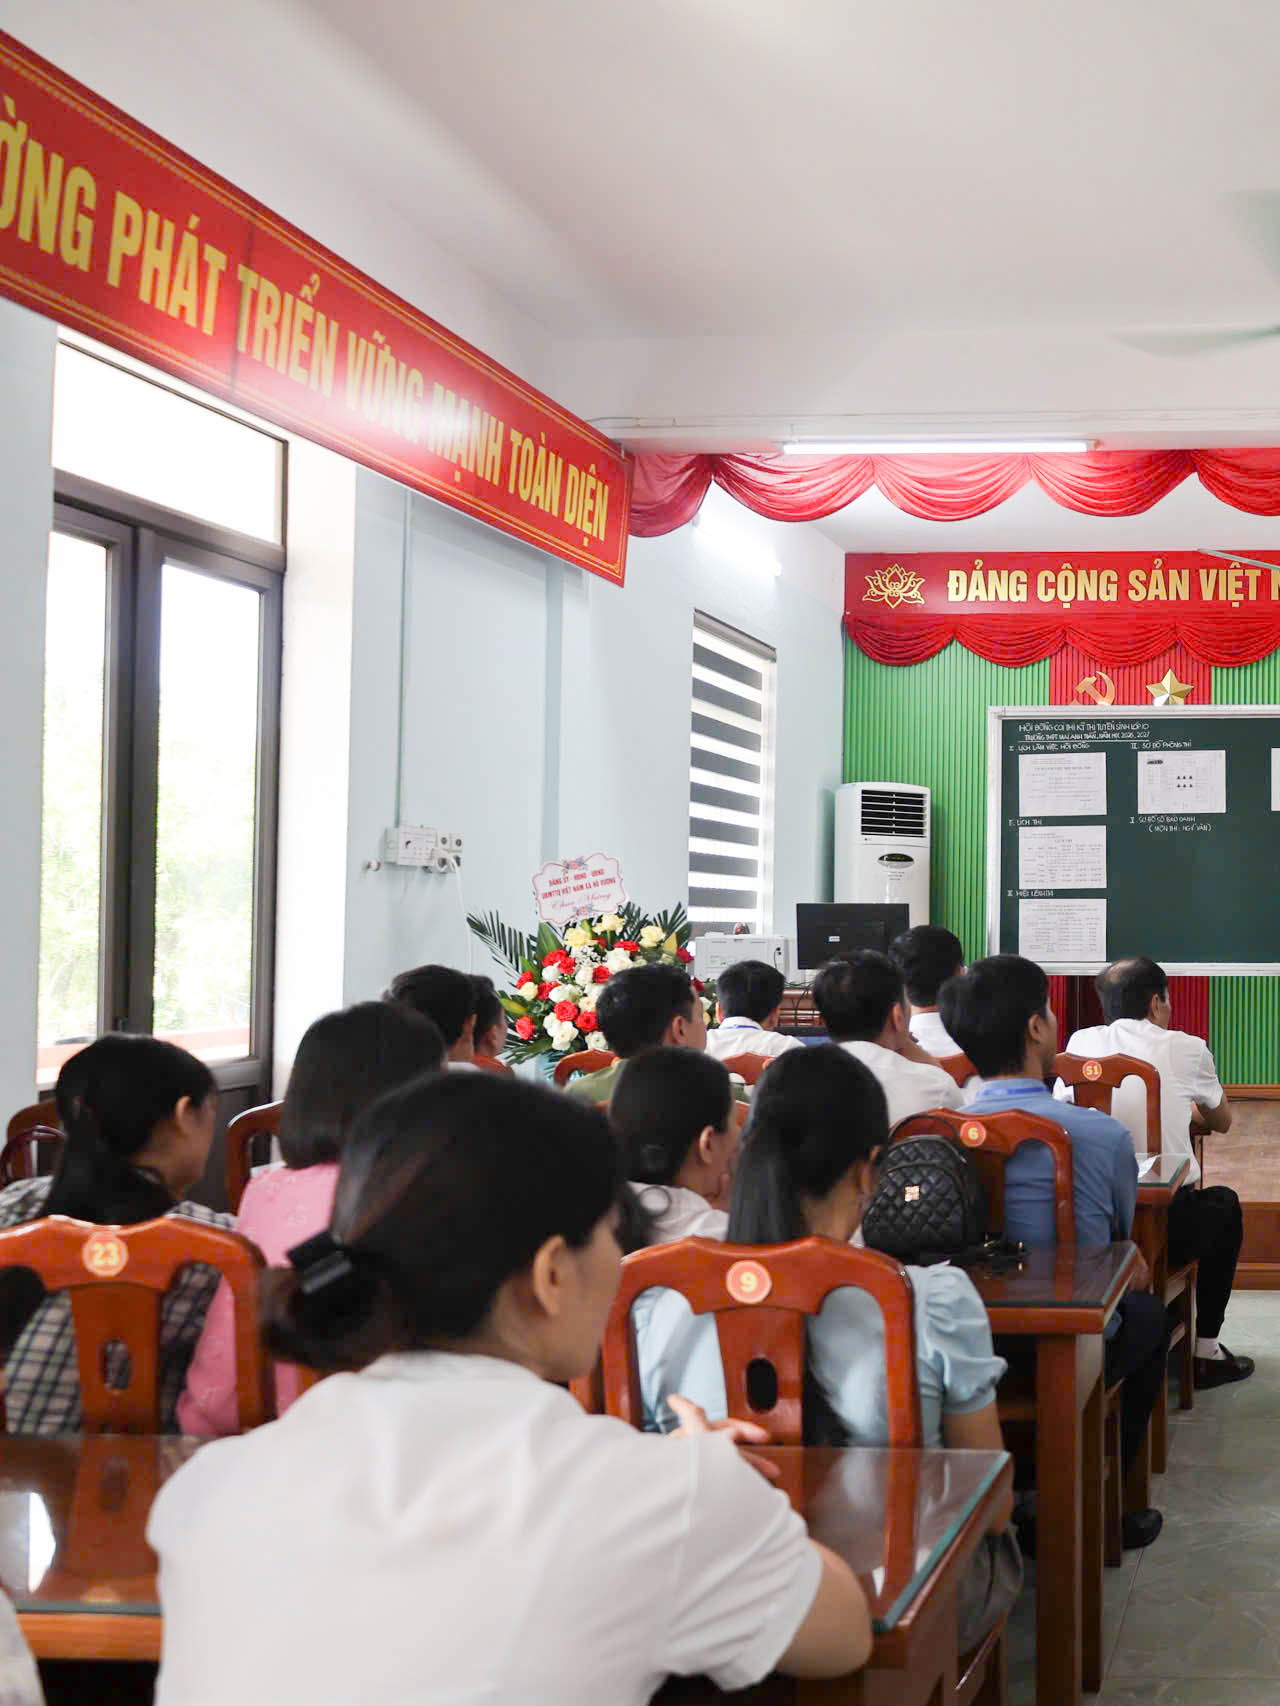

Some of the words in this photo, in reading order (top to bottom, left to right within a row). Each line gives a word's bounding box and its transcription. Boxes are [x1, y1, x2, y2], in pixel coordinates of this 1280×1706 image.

[107, 190, 227, 337] PHÁT
[237, 263, 338, 399] TRIỂN
[346, 330, 424, 444] VỮNG
[427, 381, 505, 485] MẠNH
[509, 427, 563, 520] TOÀN
[564, 463, 609, 547] DIỆN
[947, 559, 1028, 603] ĐẢNG
[1036, 562, 1118, 609] CỘNG
[1127, 558, 1190, 602] SẢN
[1199, 561, 1262, 608] VIỆT
[1086, 1065, 1098, 1075] 51
[968, 1127, 979, 1140] 6
[92, 1242, 118, 1265] 23
[739, 1272, 758, 1293] 9
